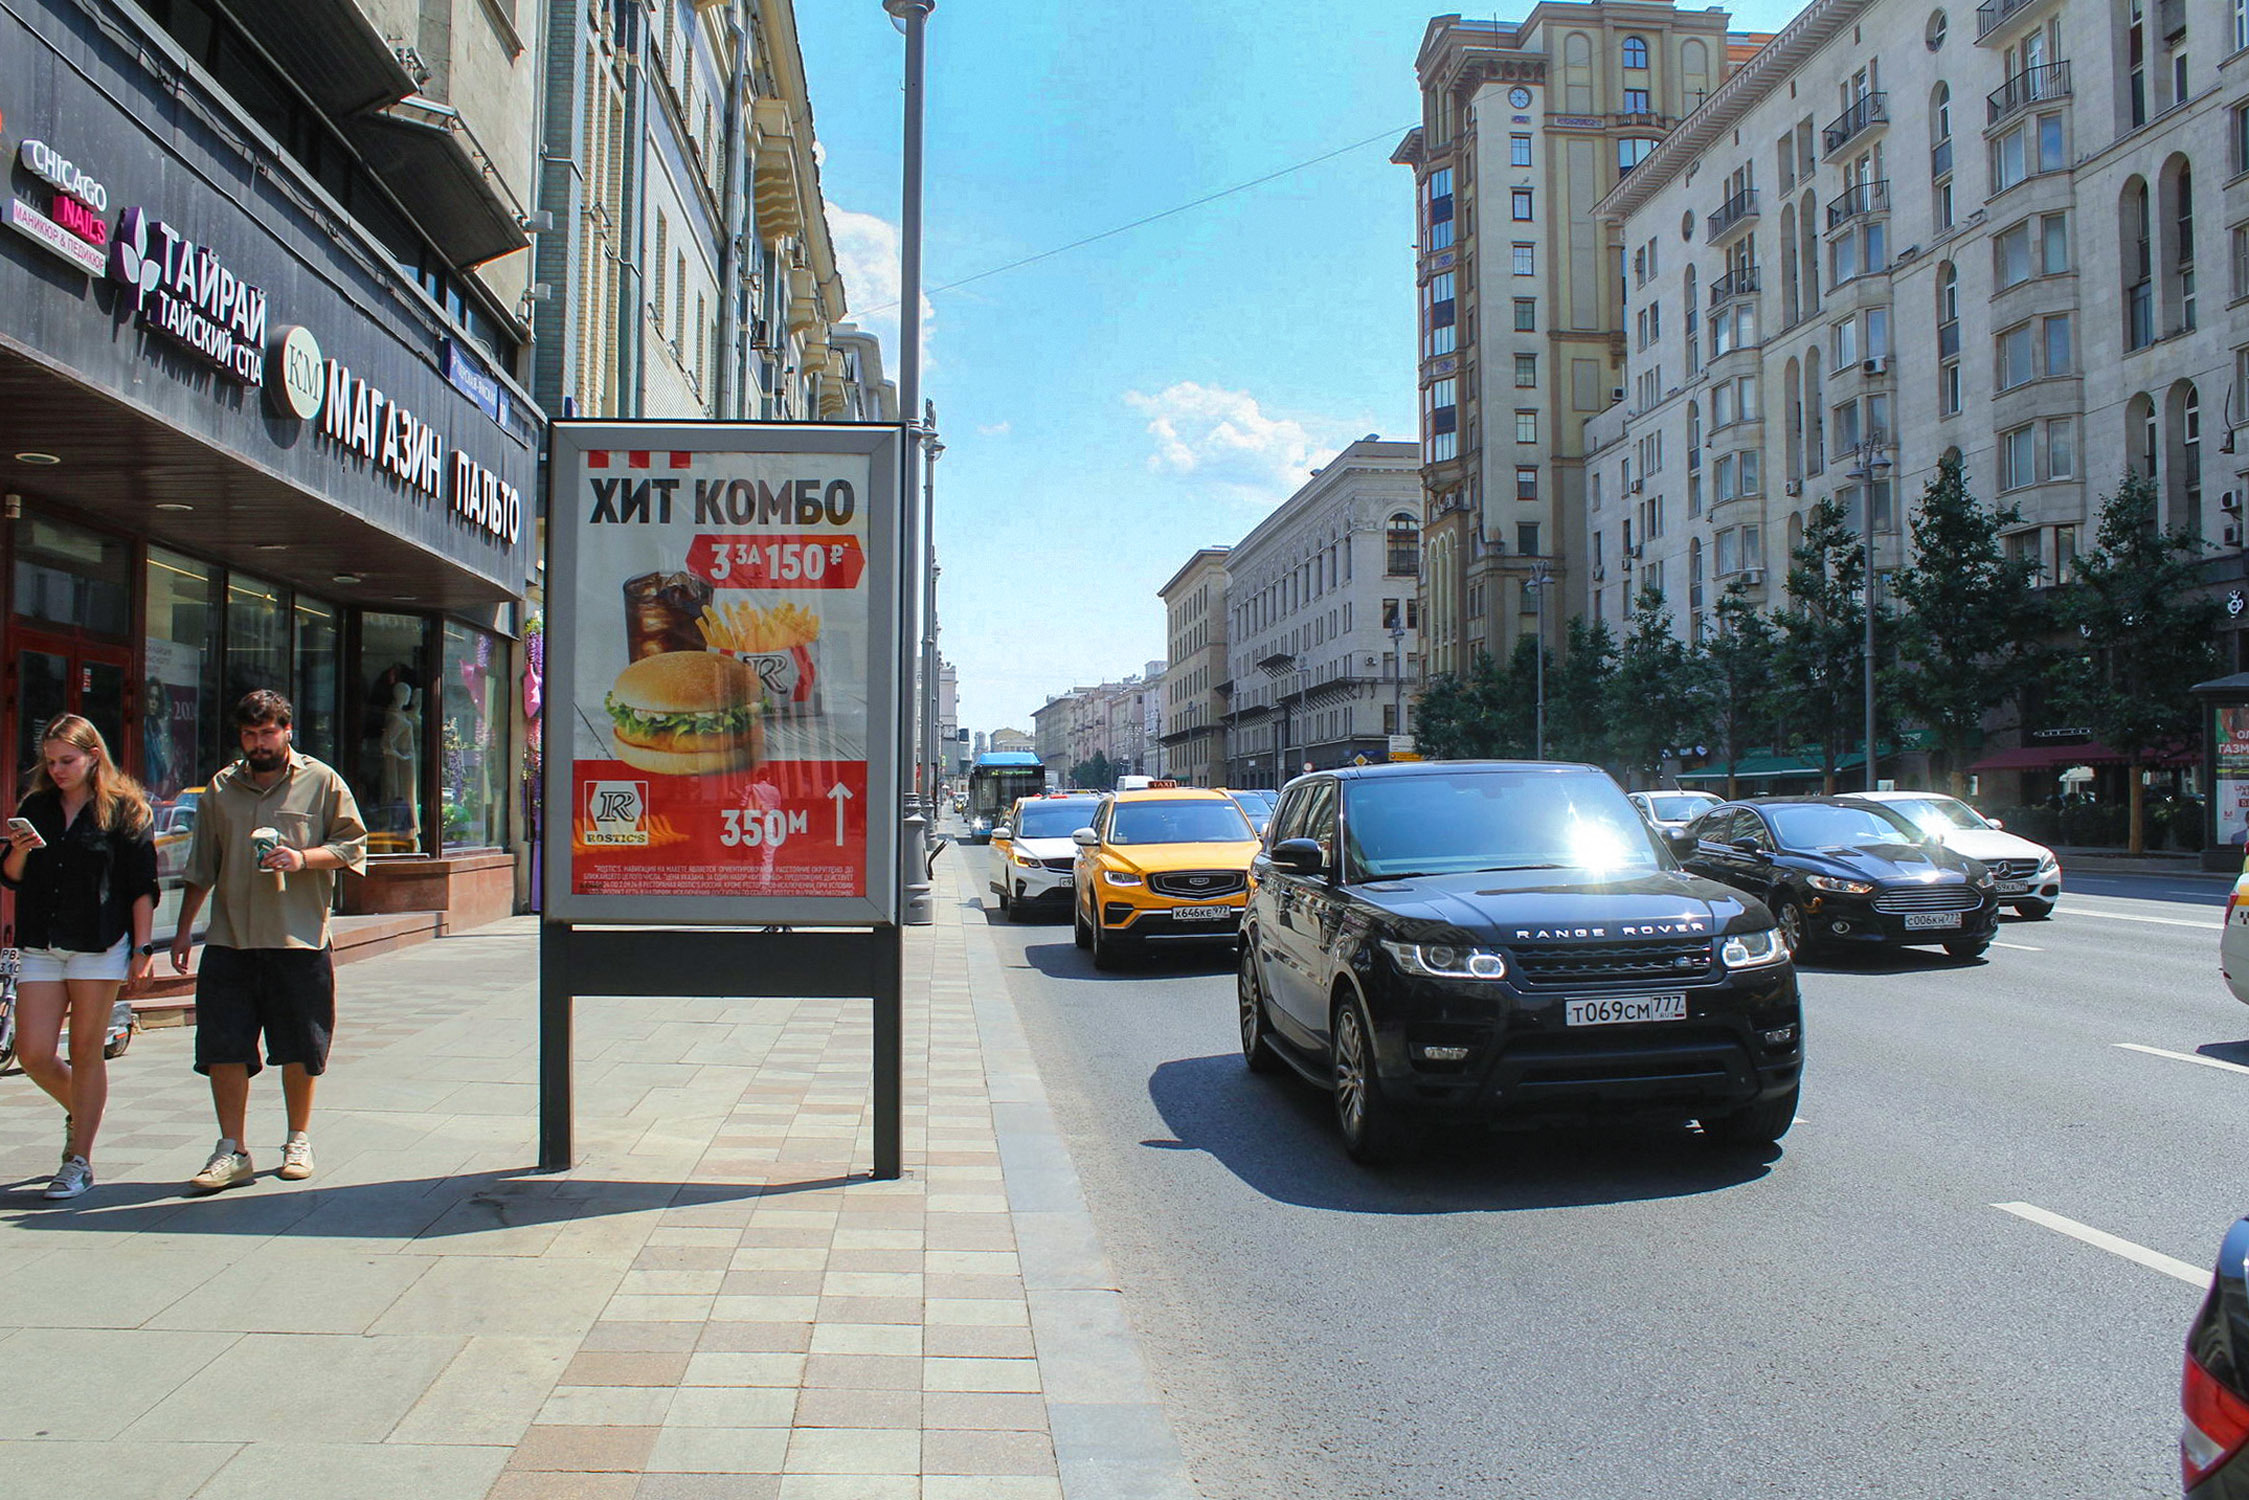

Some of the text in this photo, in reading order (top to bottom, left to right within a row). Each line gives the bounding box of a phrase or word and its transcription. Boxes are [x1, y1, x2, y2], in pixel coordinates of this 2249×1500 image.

[33, 141, 107, 212] CHICAGO
[15, 204, 104, 271] МАНИКЮР & ПЕДИКЮР
[63, 196, 107, 244] NAILS
[160, 221, 267, 349] ТАЙРАЙ
[159, 290, 263, 387] ТАЙСКИЙ СПА
[326, 358, 520, 544] МАГАЗИН ПАЛЬТО
[589, 478, 855, 526] ХИТ КОМБО
[710, 543, 731, 580] 3
[735, 544, 762, 565] ЗА
[766, 543, 826, 580] 150
[587, 833, 646, 843] ROSTIC'S
[1175, 908, 1212, 918] К646КЕ
[1515, 922, 1705, 939] RANGE ROVER
[1572, 996, 1682, 1023] Т069СМ 777
